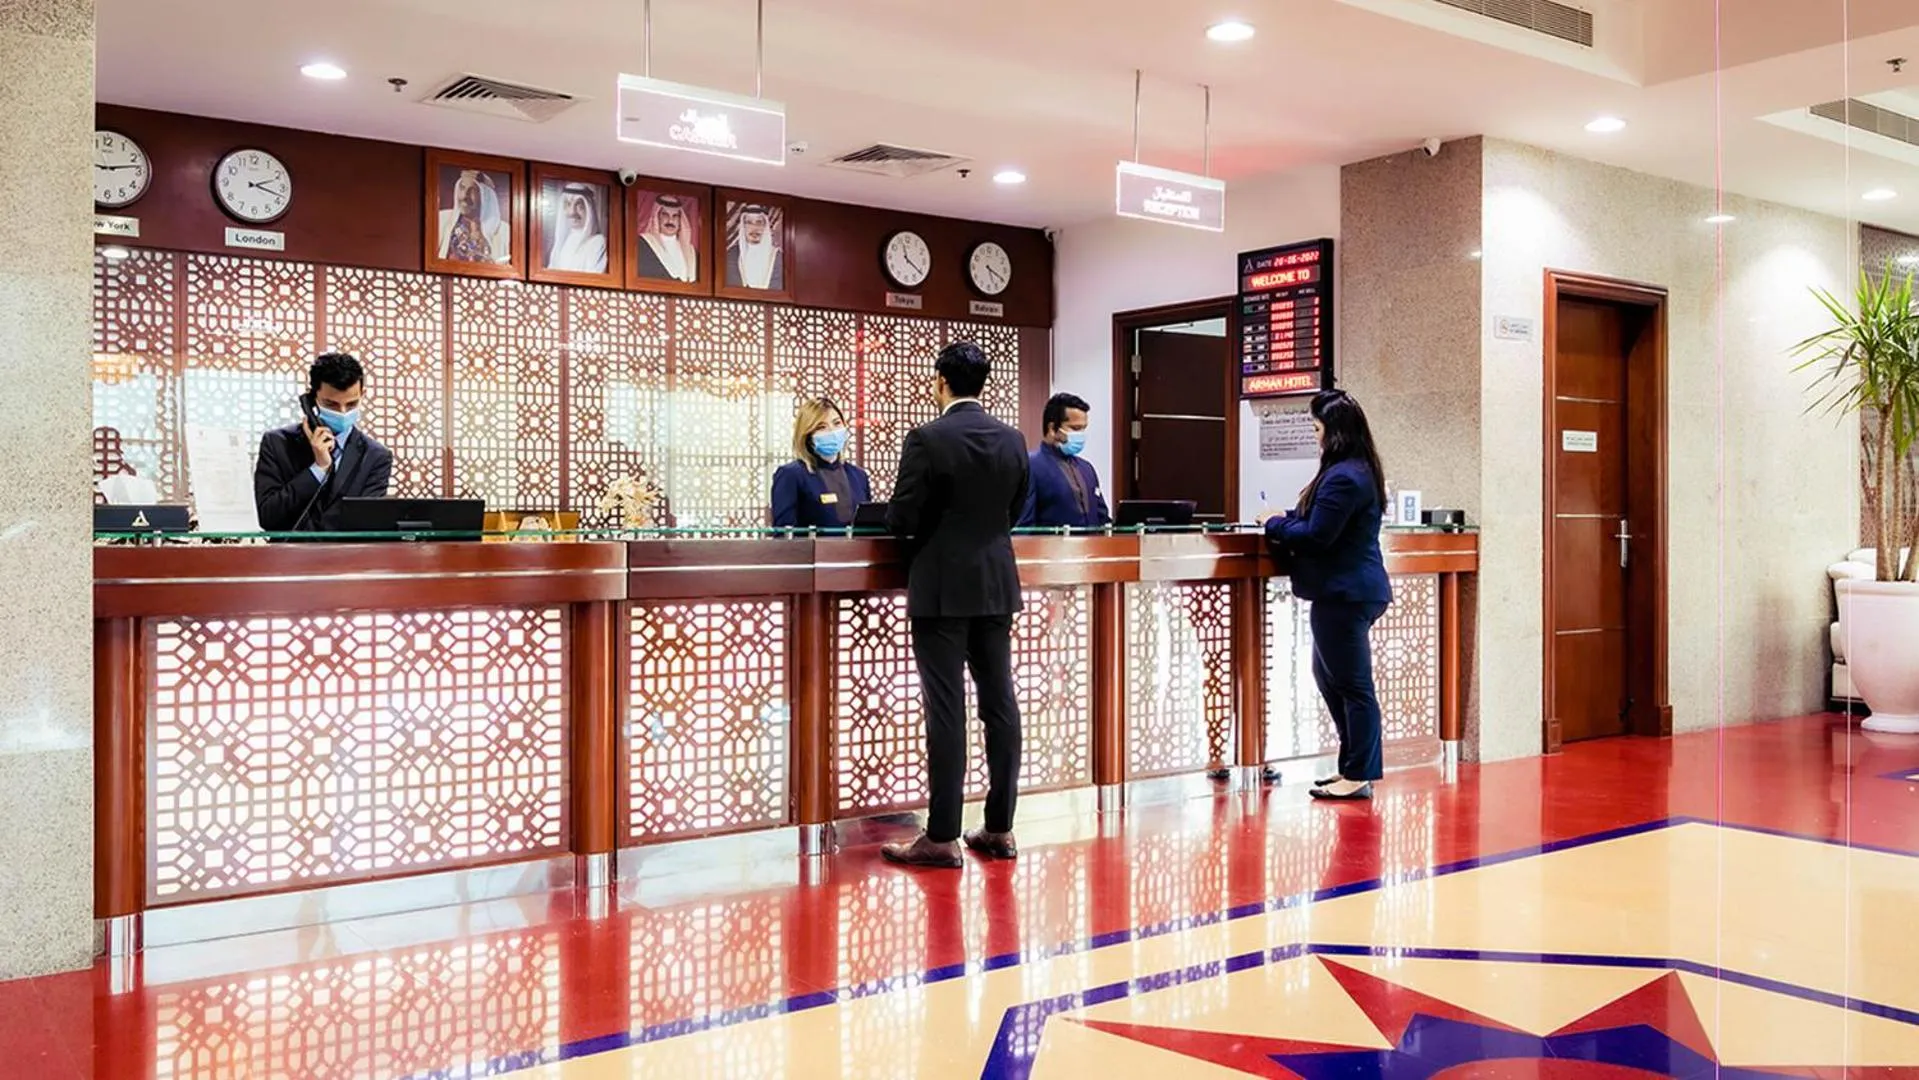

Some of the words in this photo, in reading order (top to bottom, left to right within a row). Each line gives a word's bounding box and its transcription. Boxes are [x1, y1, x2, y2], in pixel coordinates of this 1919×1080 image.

[103, 136, 114, 148] 12
[130, 153, 138, 163] 2
[249, 154, 259, 165] 12
[107, 220, 131, 231] York
[235, 233, 275, 246] London
[1251, 270, 1296, 288] WELCOME
[1297, 268, 1311, 281] TO
[1284, 374, 1313, 389] HOTEL
